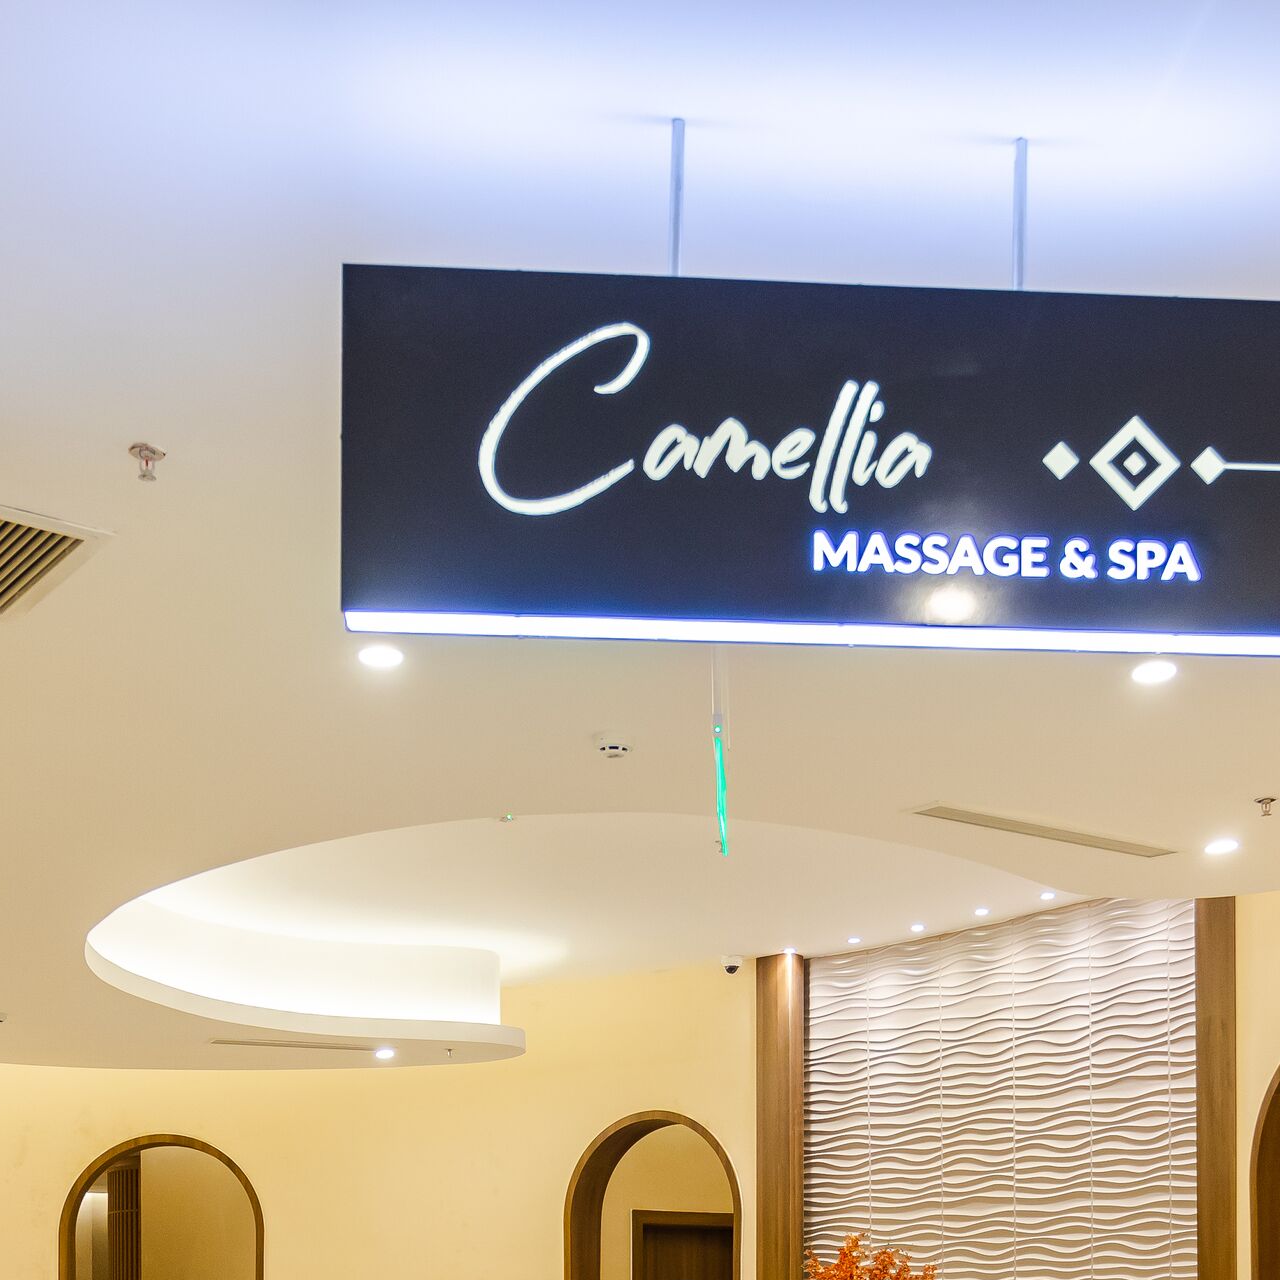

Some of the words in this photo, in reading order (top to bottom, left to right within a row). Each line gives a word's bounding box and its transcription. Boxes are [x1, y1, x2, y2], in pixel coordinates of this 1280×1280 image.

[477, 321, 933, 516] Camellia
[812, 530, 1051, 580] MASSAGE
[1058, 538, 1099, 579] &
[1106, 539, 1202, 582] SPA
